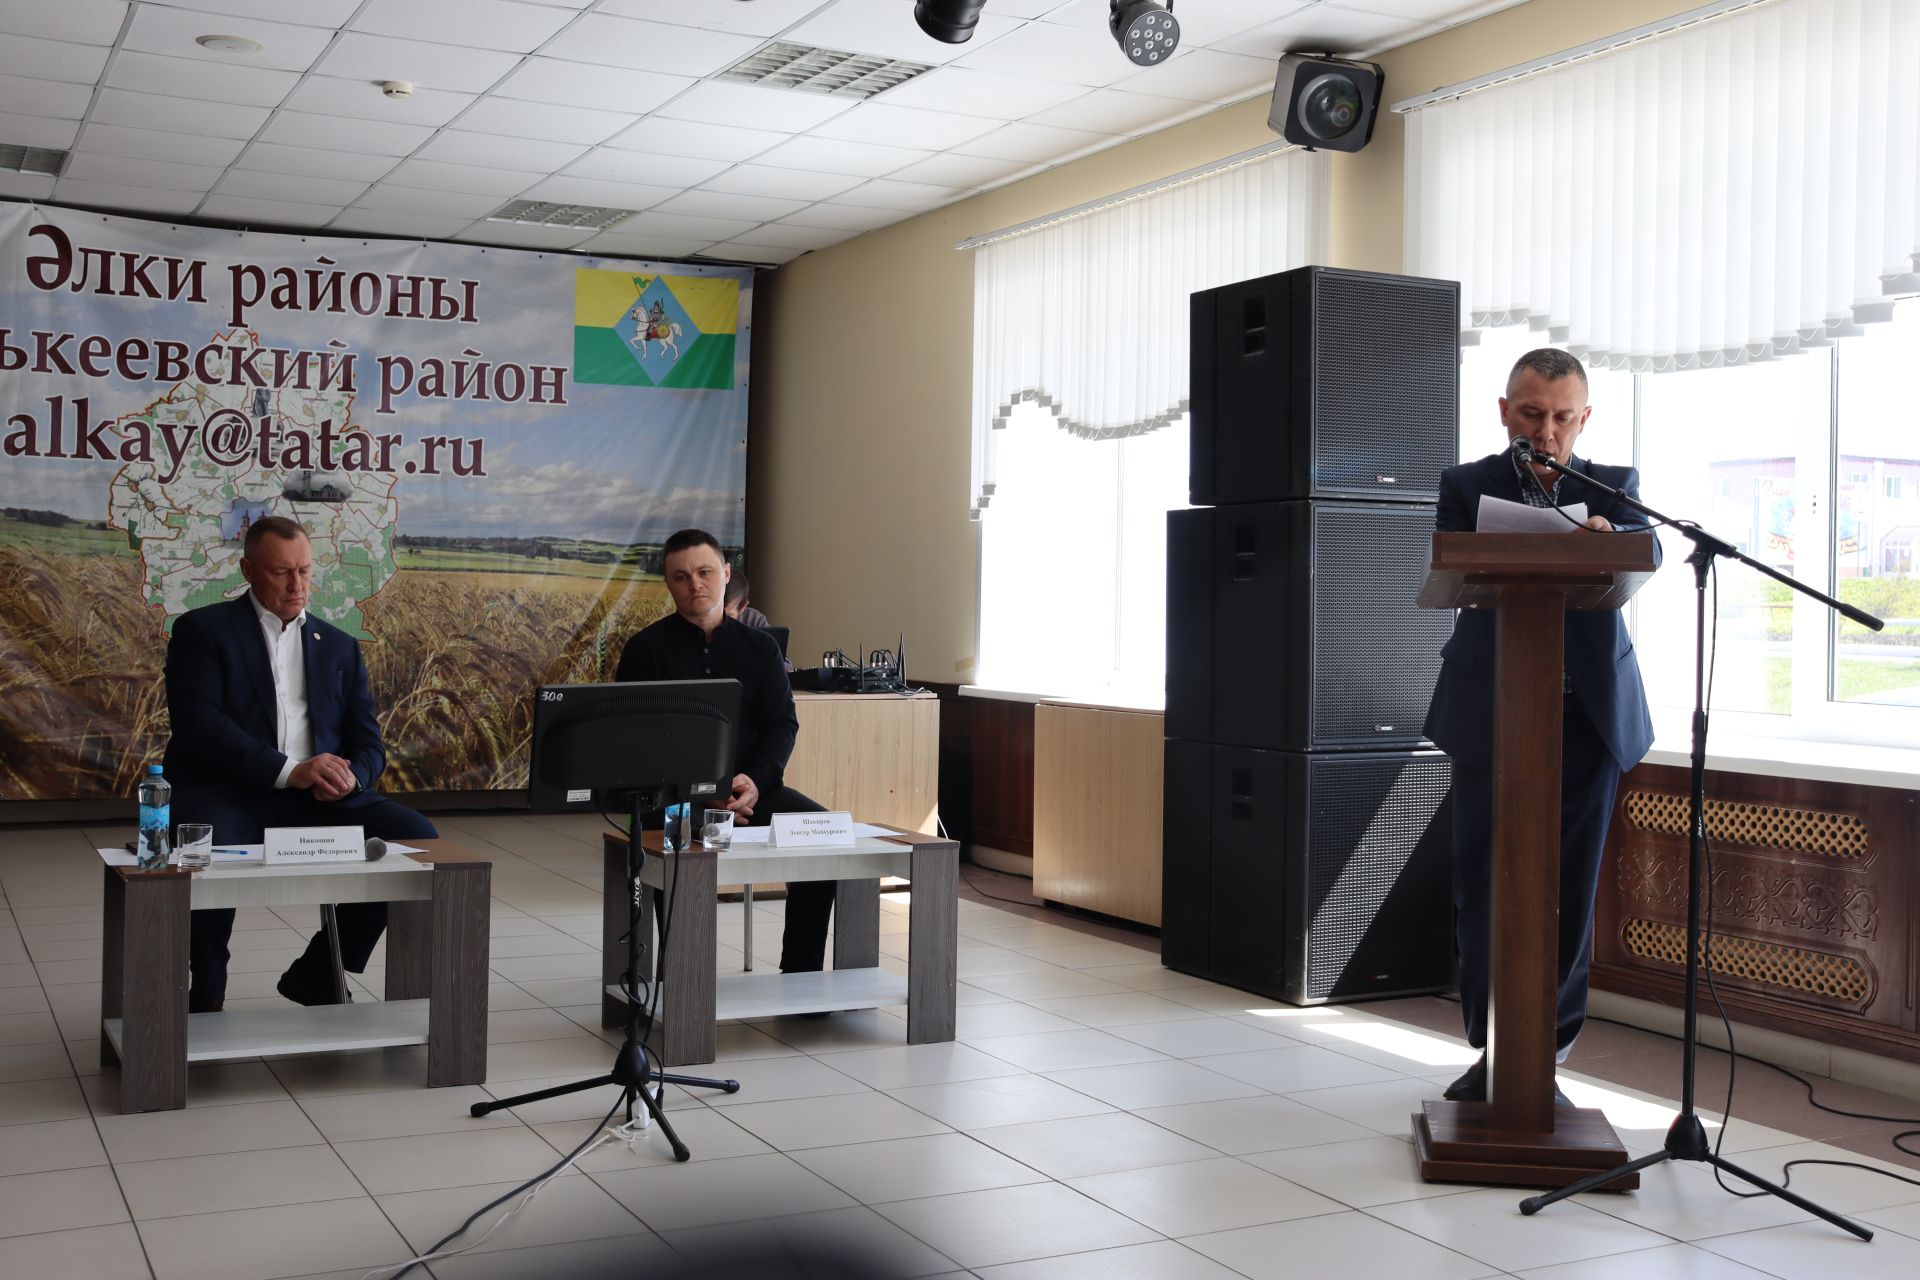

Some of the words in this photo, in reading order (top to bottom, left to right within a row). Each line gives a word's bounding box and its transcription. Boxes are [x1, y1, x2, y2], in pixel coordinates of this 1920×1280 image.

[26, 224, 207, 303] Әлки
[227, 256, 479, 328] районы
[0, 329, 357, 392] ькеевский
[376, 349, 568, 414] район
[3, 395, 487, 484] alkay@tatar.ru
[276, 849, 316, 857] Александр
